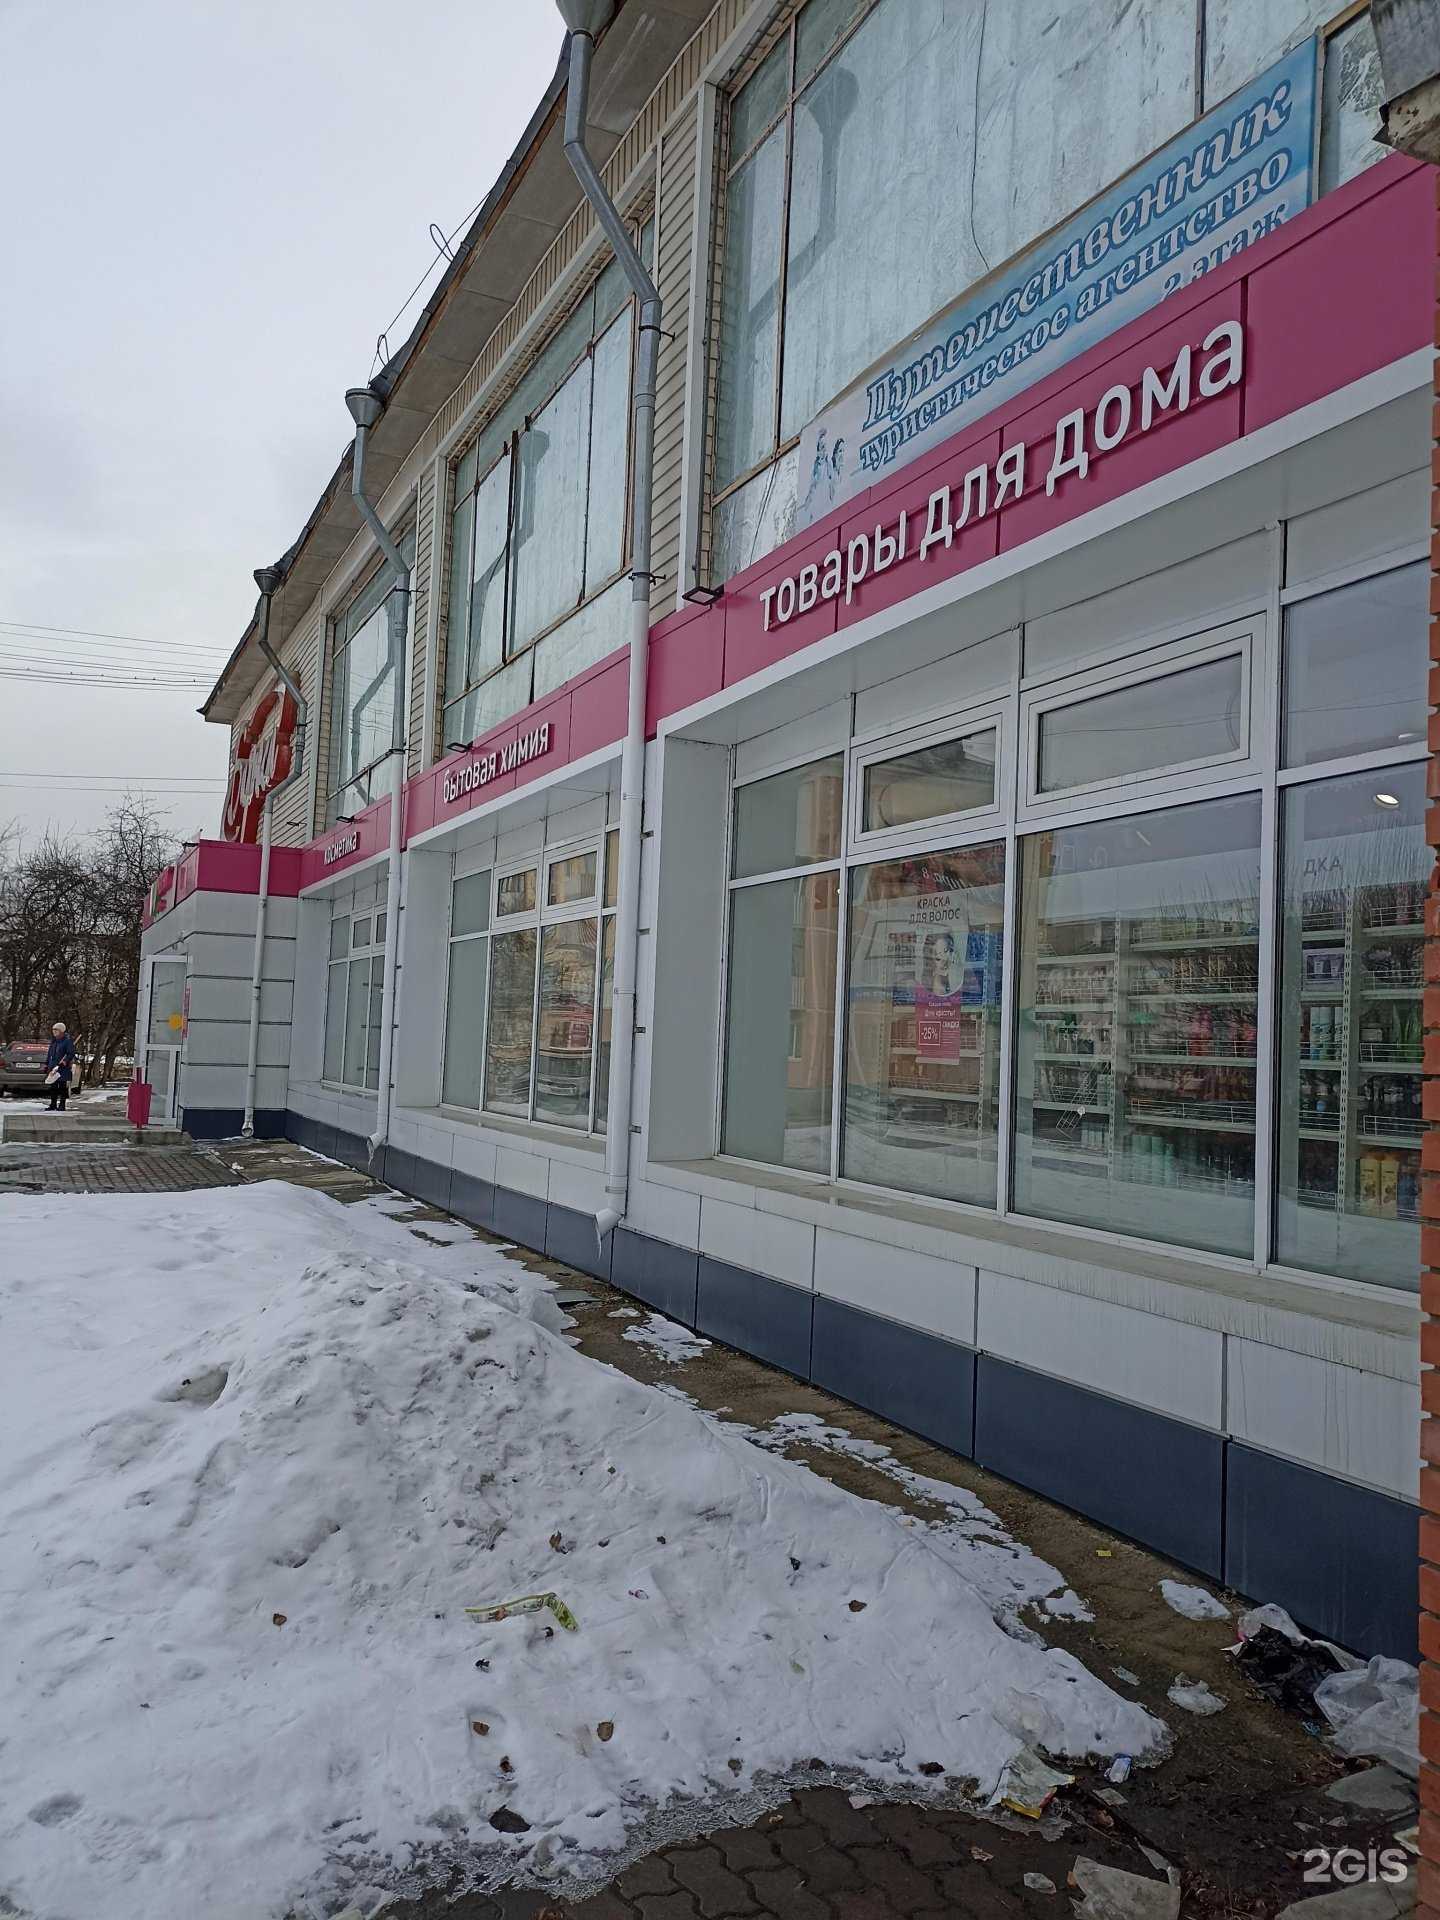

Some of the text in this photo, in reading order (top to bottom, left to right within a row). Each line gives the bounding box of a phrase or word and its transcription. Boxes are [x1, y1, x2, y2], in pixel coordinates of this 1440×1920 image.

[862, 79, 1293, 432] Путешественник
[1162, 271, 1182, 300] 2
[859, 147, 1292, 472] туристическое агентство
[759, 320, 1244, 632] товары для дома
[443, 722, 549, 804] бытовая химия
[917, 895, 951, 909] КРАСКА
[929, 908, 960, 921] ВОЛОС
